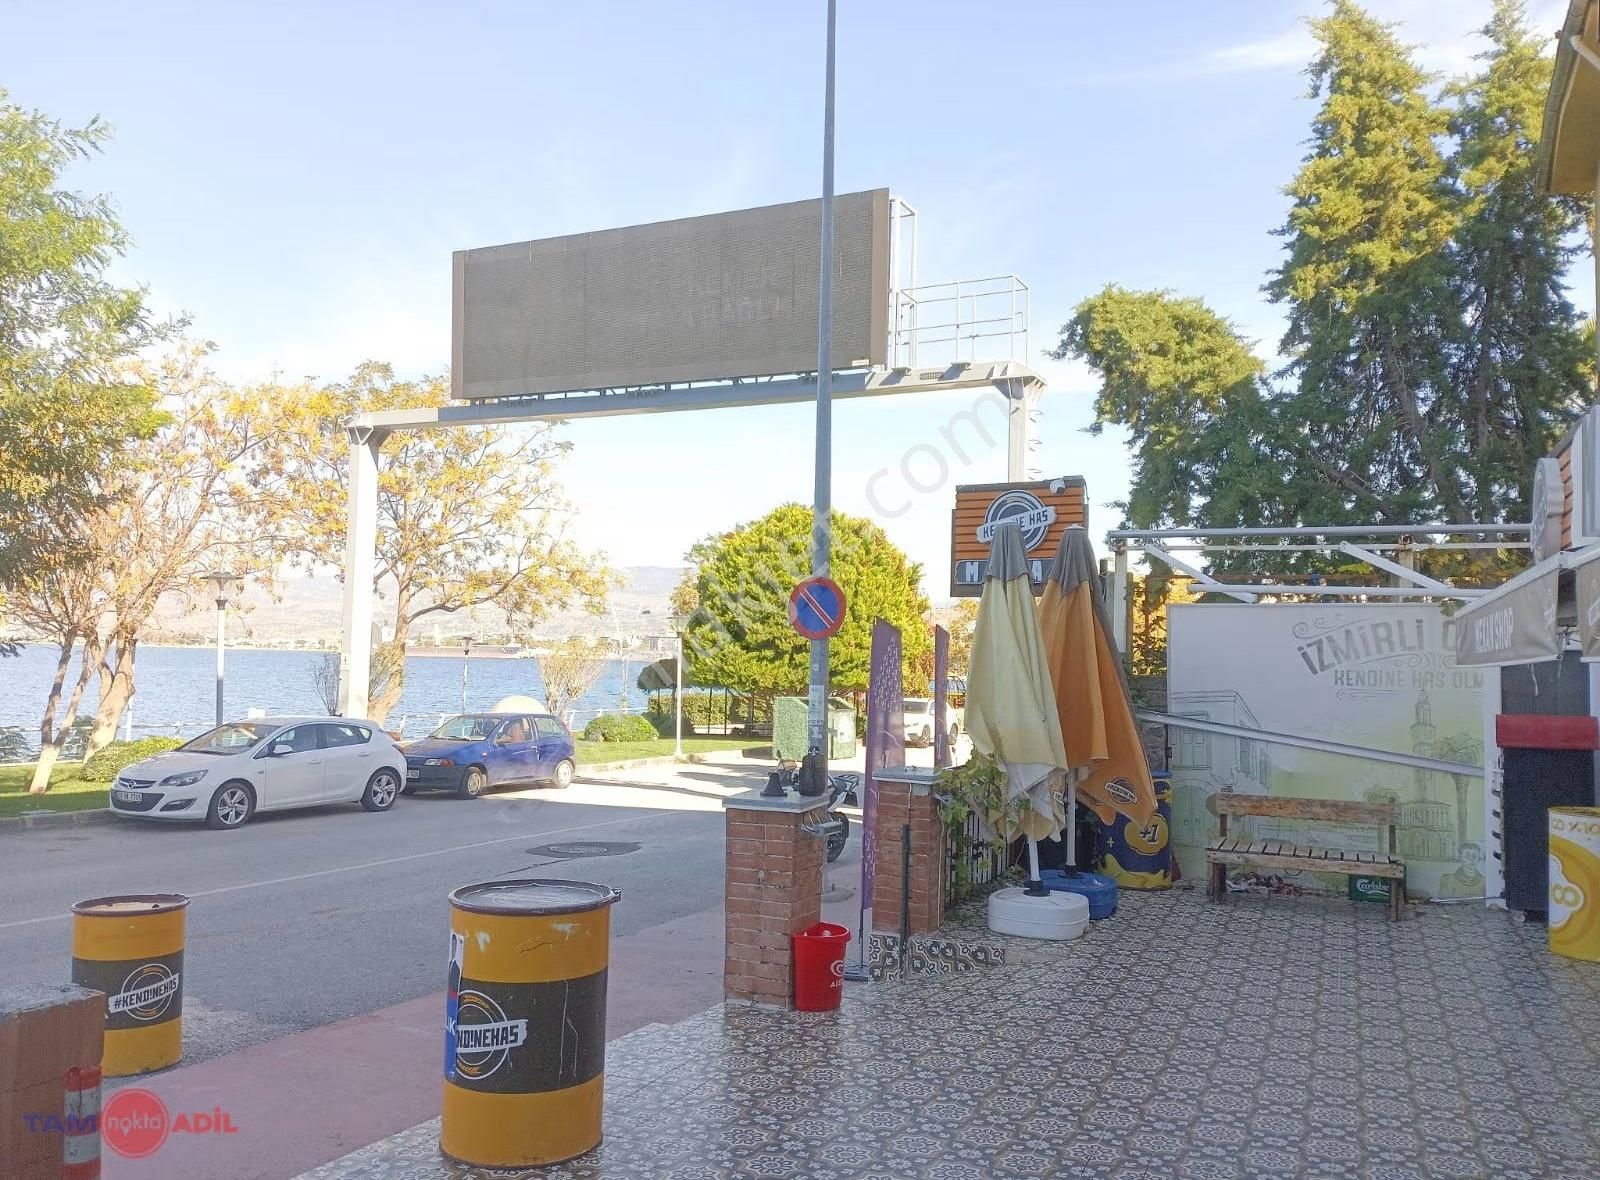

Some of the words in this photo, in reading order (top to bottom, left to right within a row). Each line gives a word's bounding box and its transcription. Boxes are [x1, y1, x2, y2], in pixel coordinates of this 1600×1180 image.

[1029, 509, 1048, 526] HAS
[1494, 607, 1514, 651] SHOP
[1297, 618, 1424, 675] İZMİRLİ
[1412, 671, 1445, 688] HAS
